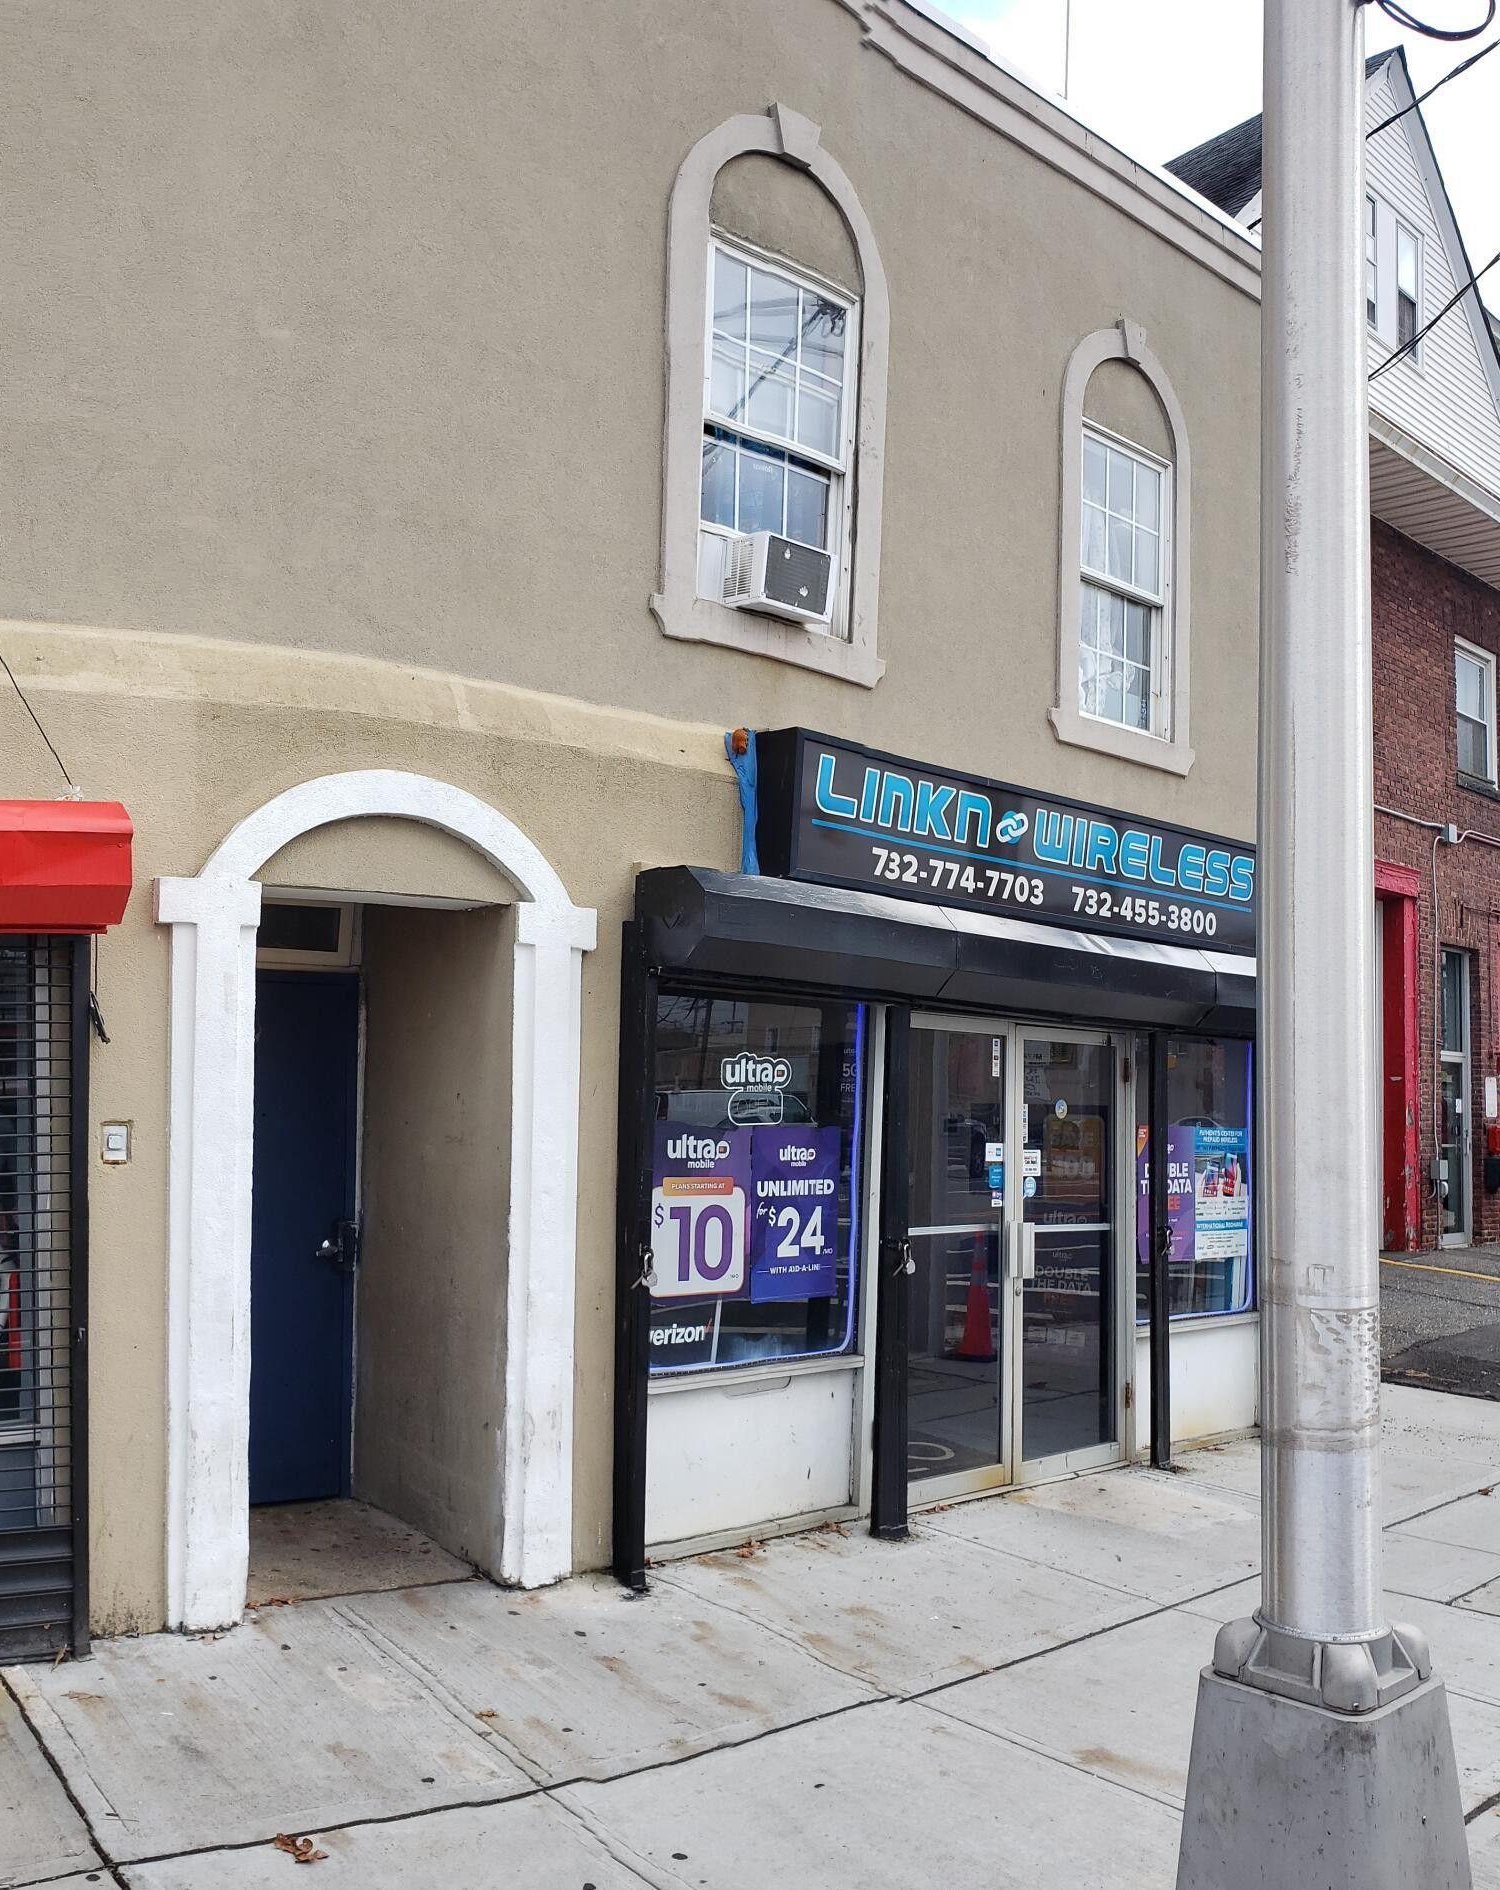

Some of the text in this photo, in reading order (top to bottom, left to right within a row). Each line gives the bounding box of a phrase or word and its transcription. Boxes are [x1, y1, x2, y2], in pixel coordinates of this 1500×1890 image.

[1032, 807, 1255, 902] WIRELESS
[871, 847, 1217, 936] 732-774-7703 732-455-3800
[725, 1058, 774, 1083] ultra
[746, 1083, 772, 1092] mobile
[667, 1133, 716, 1159] ultra
[779, 1145, 807, 1161] ultra
[687, 1160, 715, 1169] mobile
[756, 1178, 835, 1197] UNLIMITED
[769, 1266, 787, 1274] WITH
